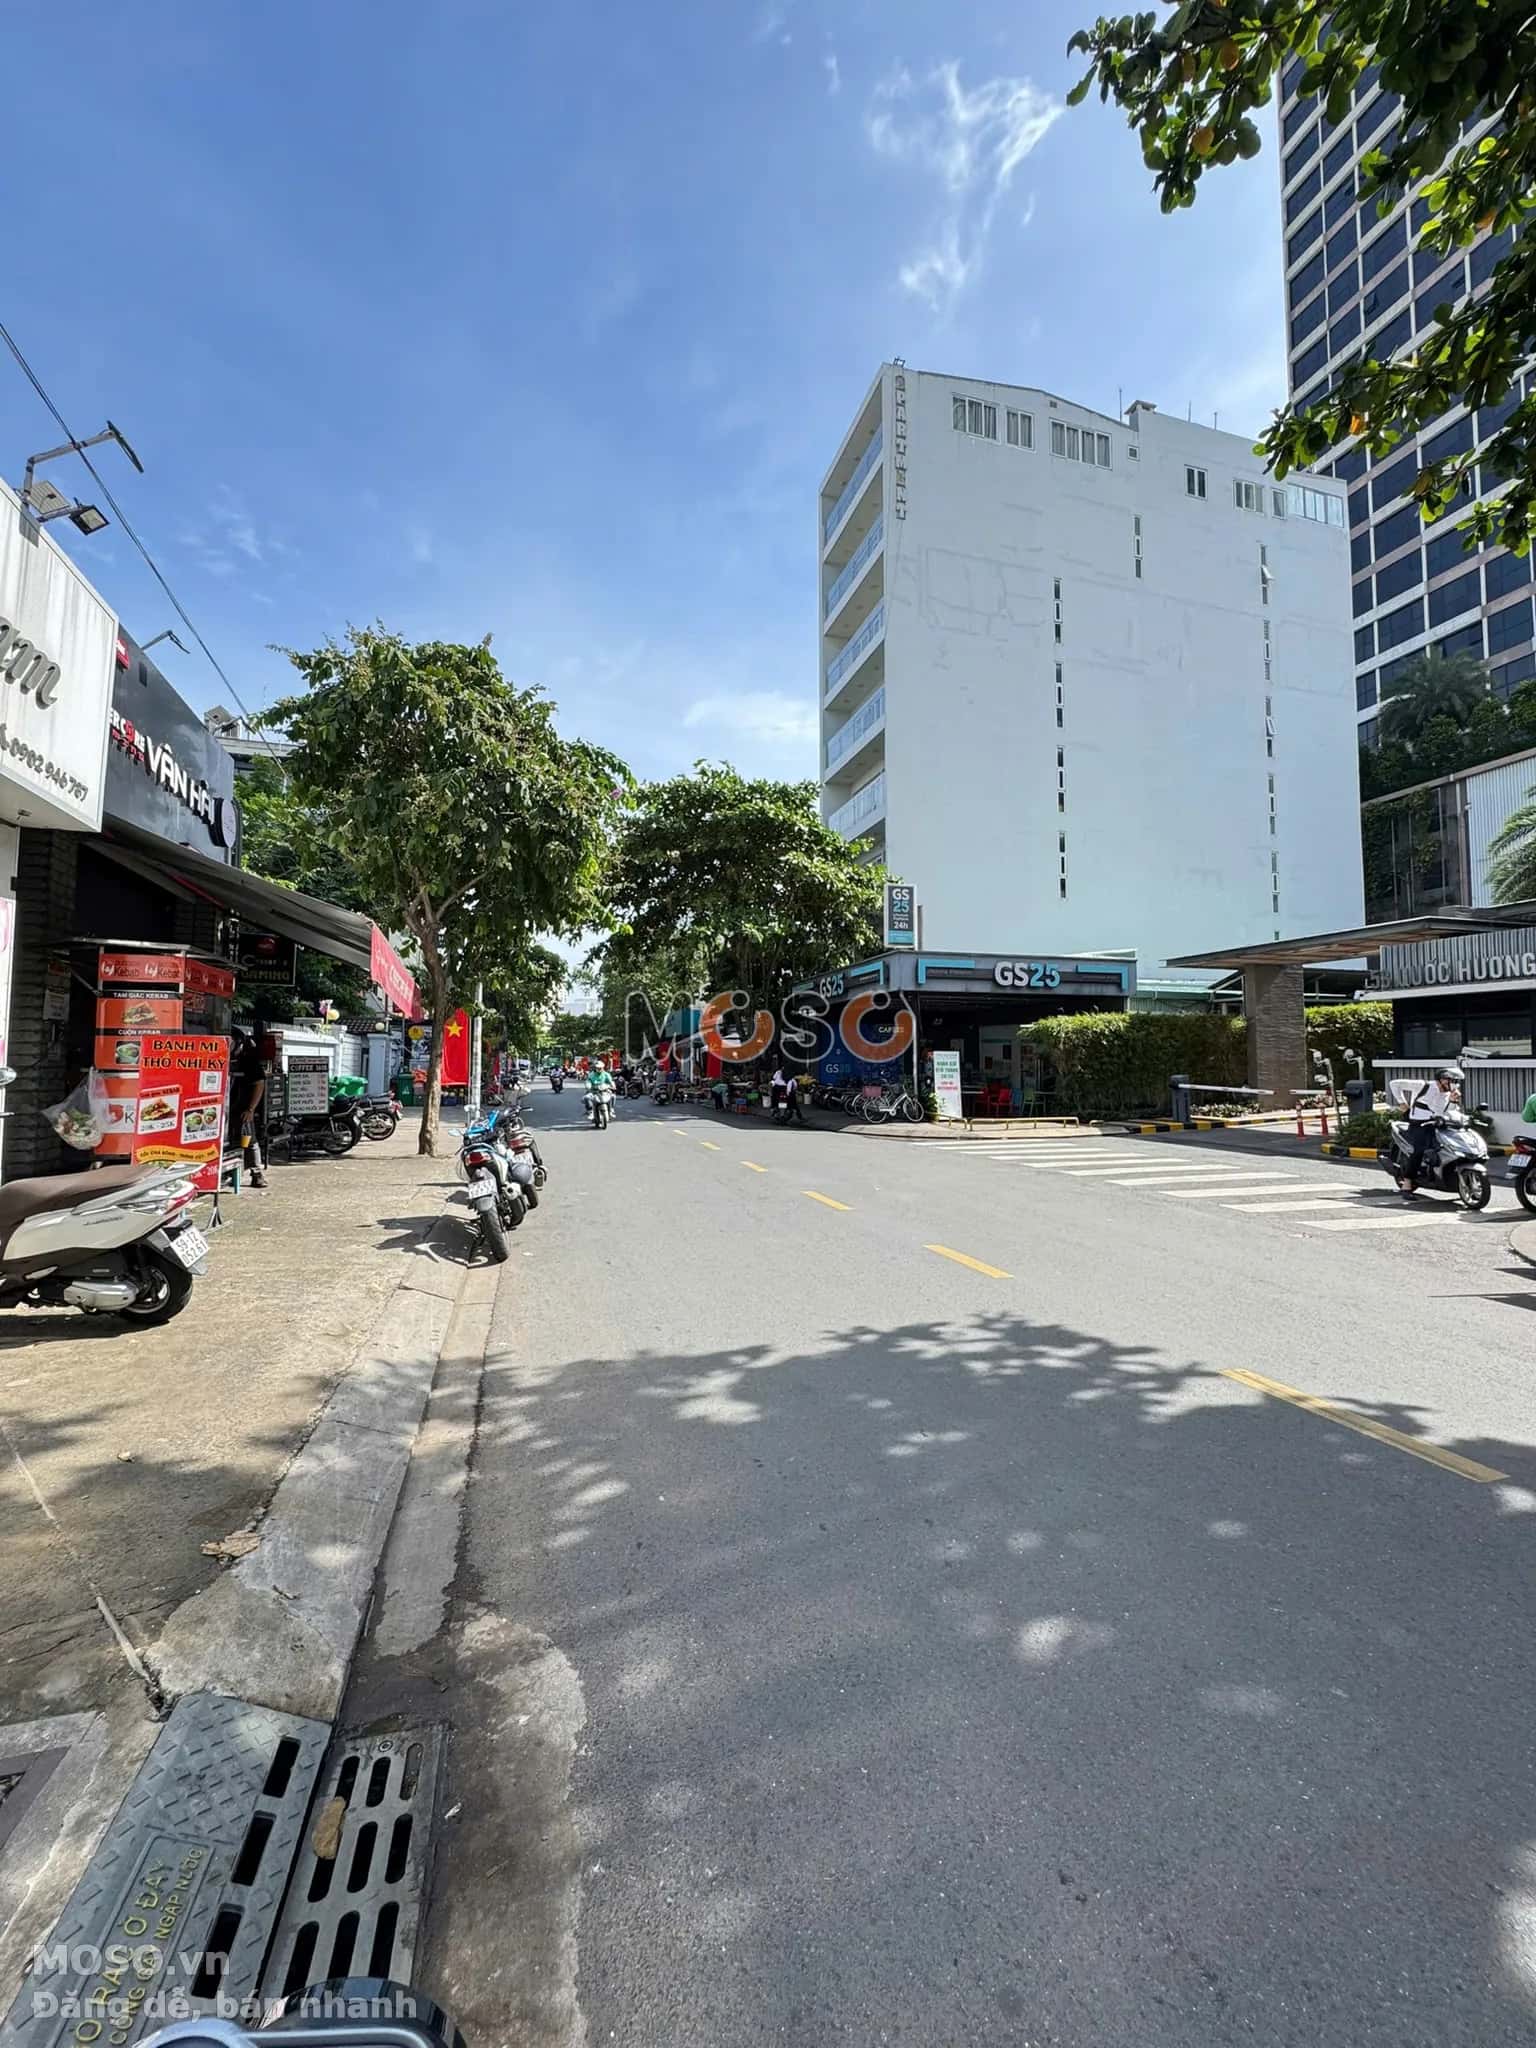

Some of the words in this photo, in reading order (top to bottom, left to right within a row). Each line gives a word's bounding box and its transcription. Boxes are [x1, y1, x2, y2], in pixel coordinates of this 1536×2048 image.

[147, 735, 187, 799] VÂN
[892, 888, 909, 900] GS
[893, 900, 909, 912] 25
[893, 921, 909, 929] 24h
[995, 961, 1060, 987] GS25
[819, 973, 845, 998] GS25
